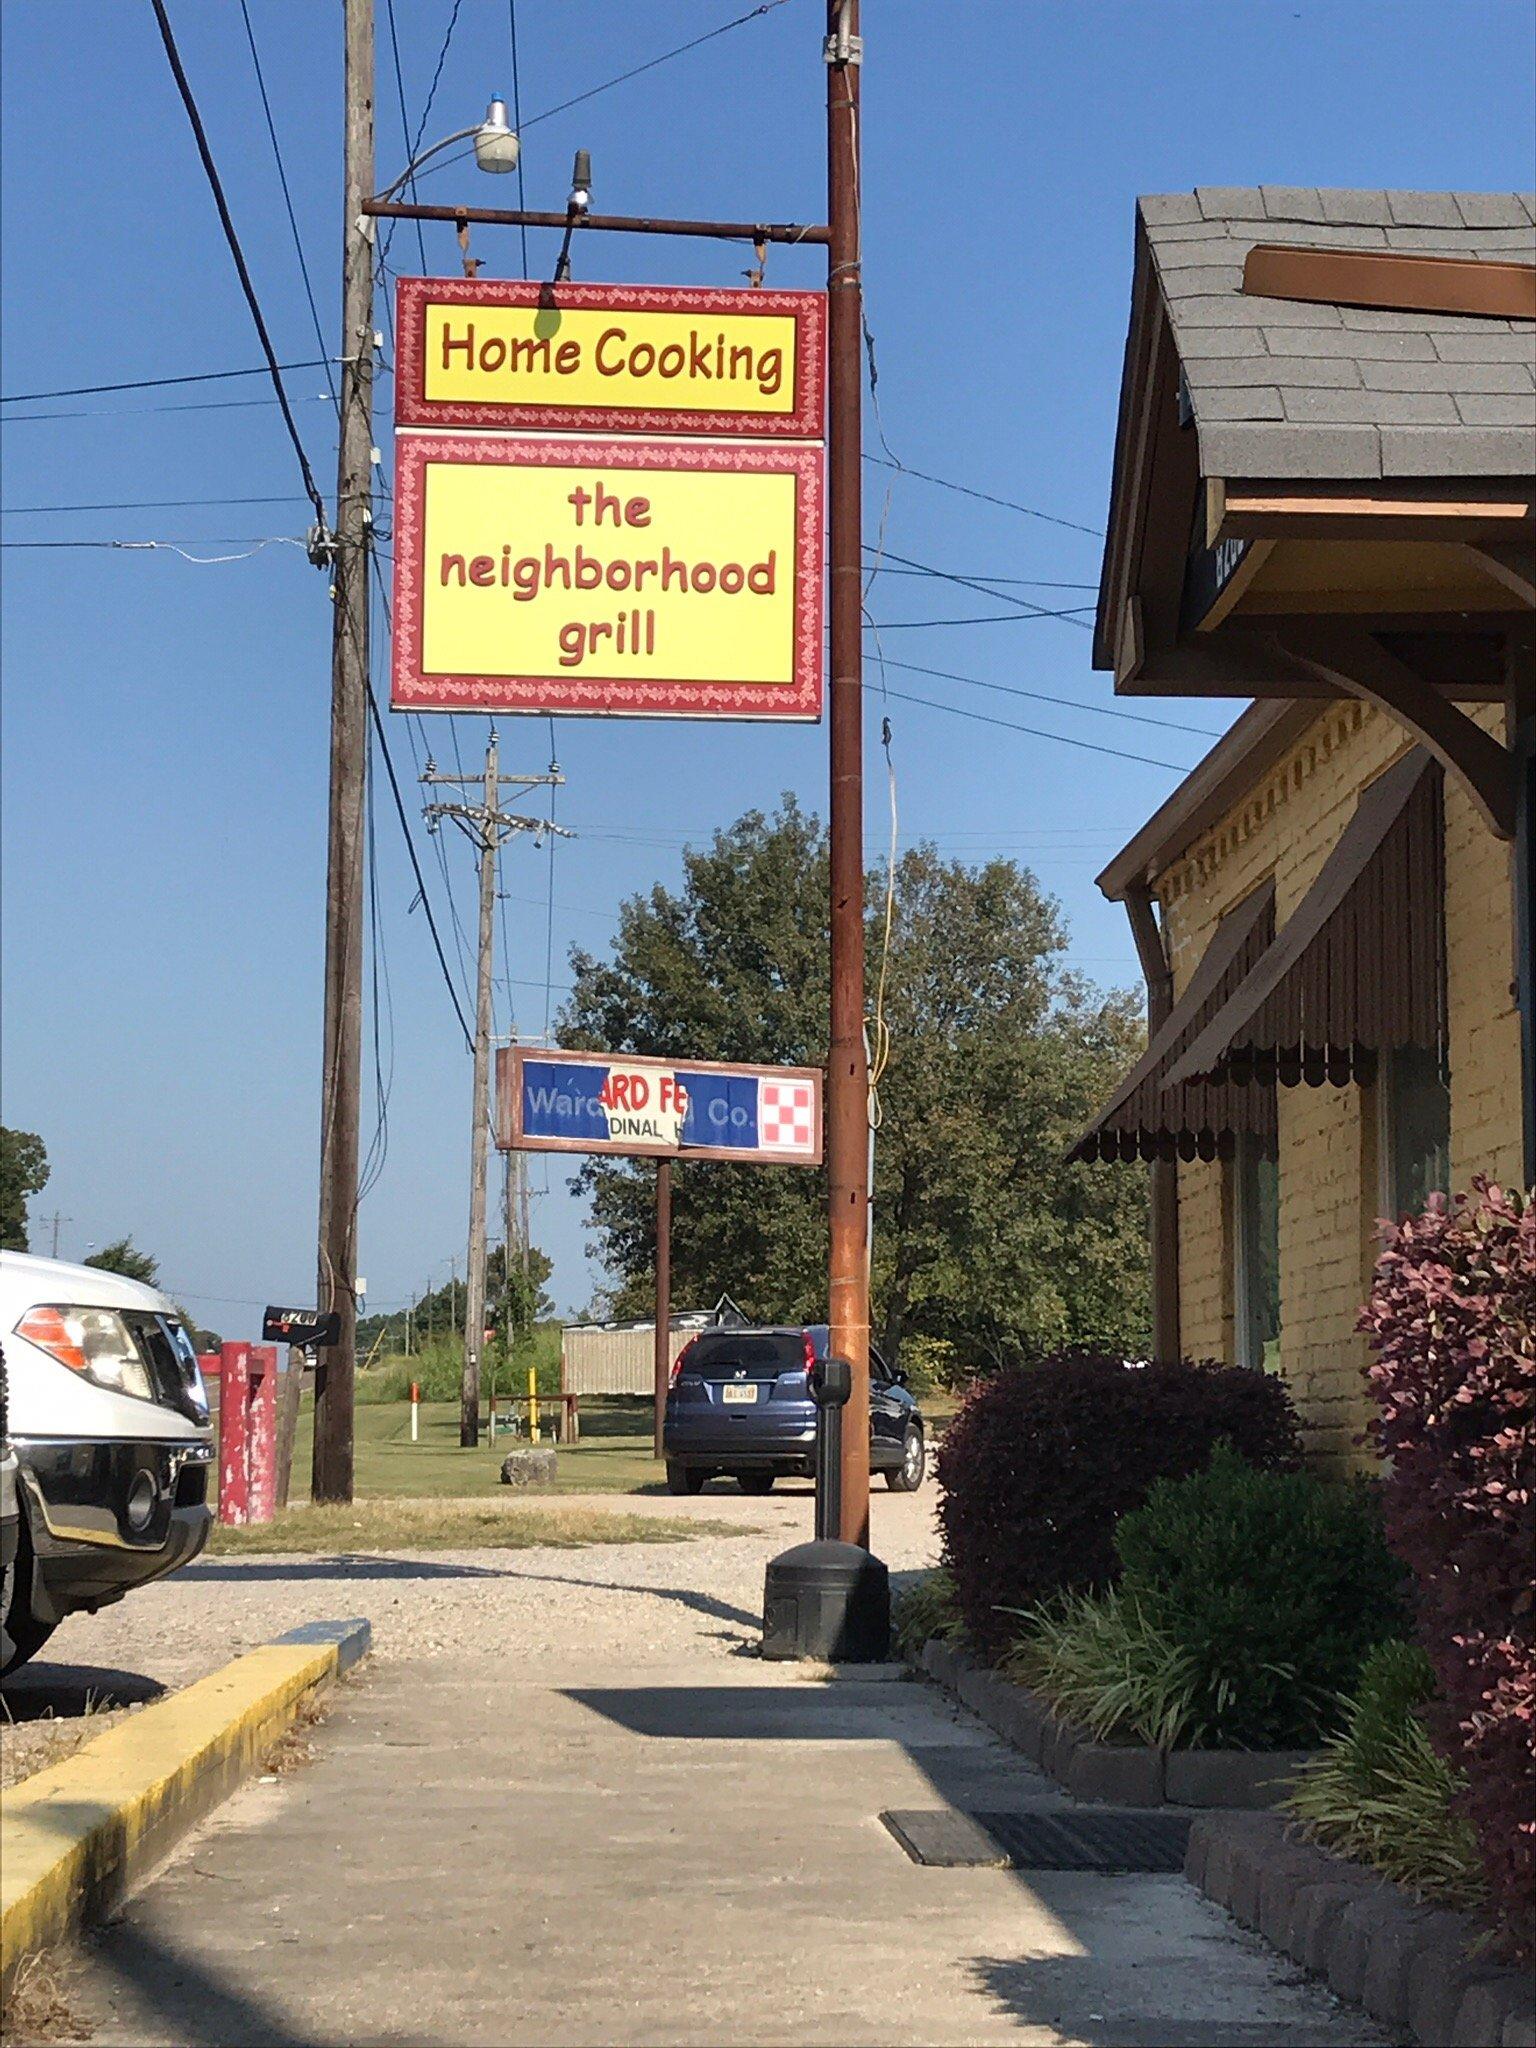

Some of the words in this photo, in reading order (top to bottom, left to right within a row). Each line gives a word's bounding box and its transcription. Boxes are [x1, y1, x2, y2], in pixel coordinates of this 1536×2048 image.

[442, 323, 580, 374] Home
[595, 327, 782, 394] Cooking
[568, 482, 652, 528] the
[440, 544, 776, 601] neighborhood
[559, 609, 655, 666] grill
[610, 1117, 663, 1138] DINAL
[708, 1098, 756, 1128] Co.
